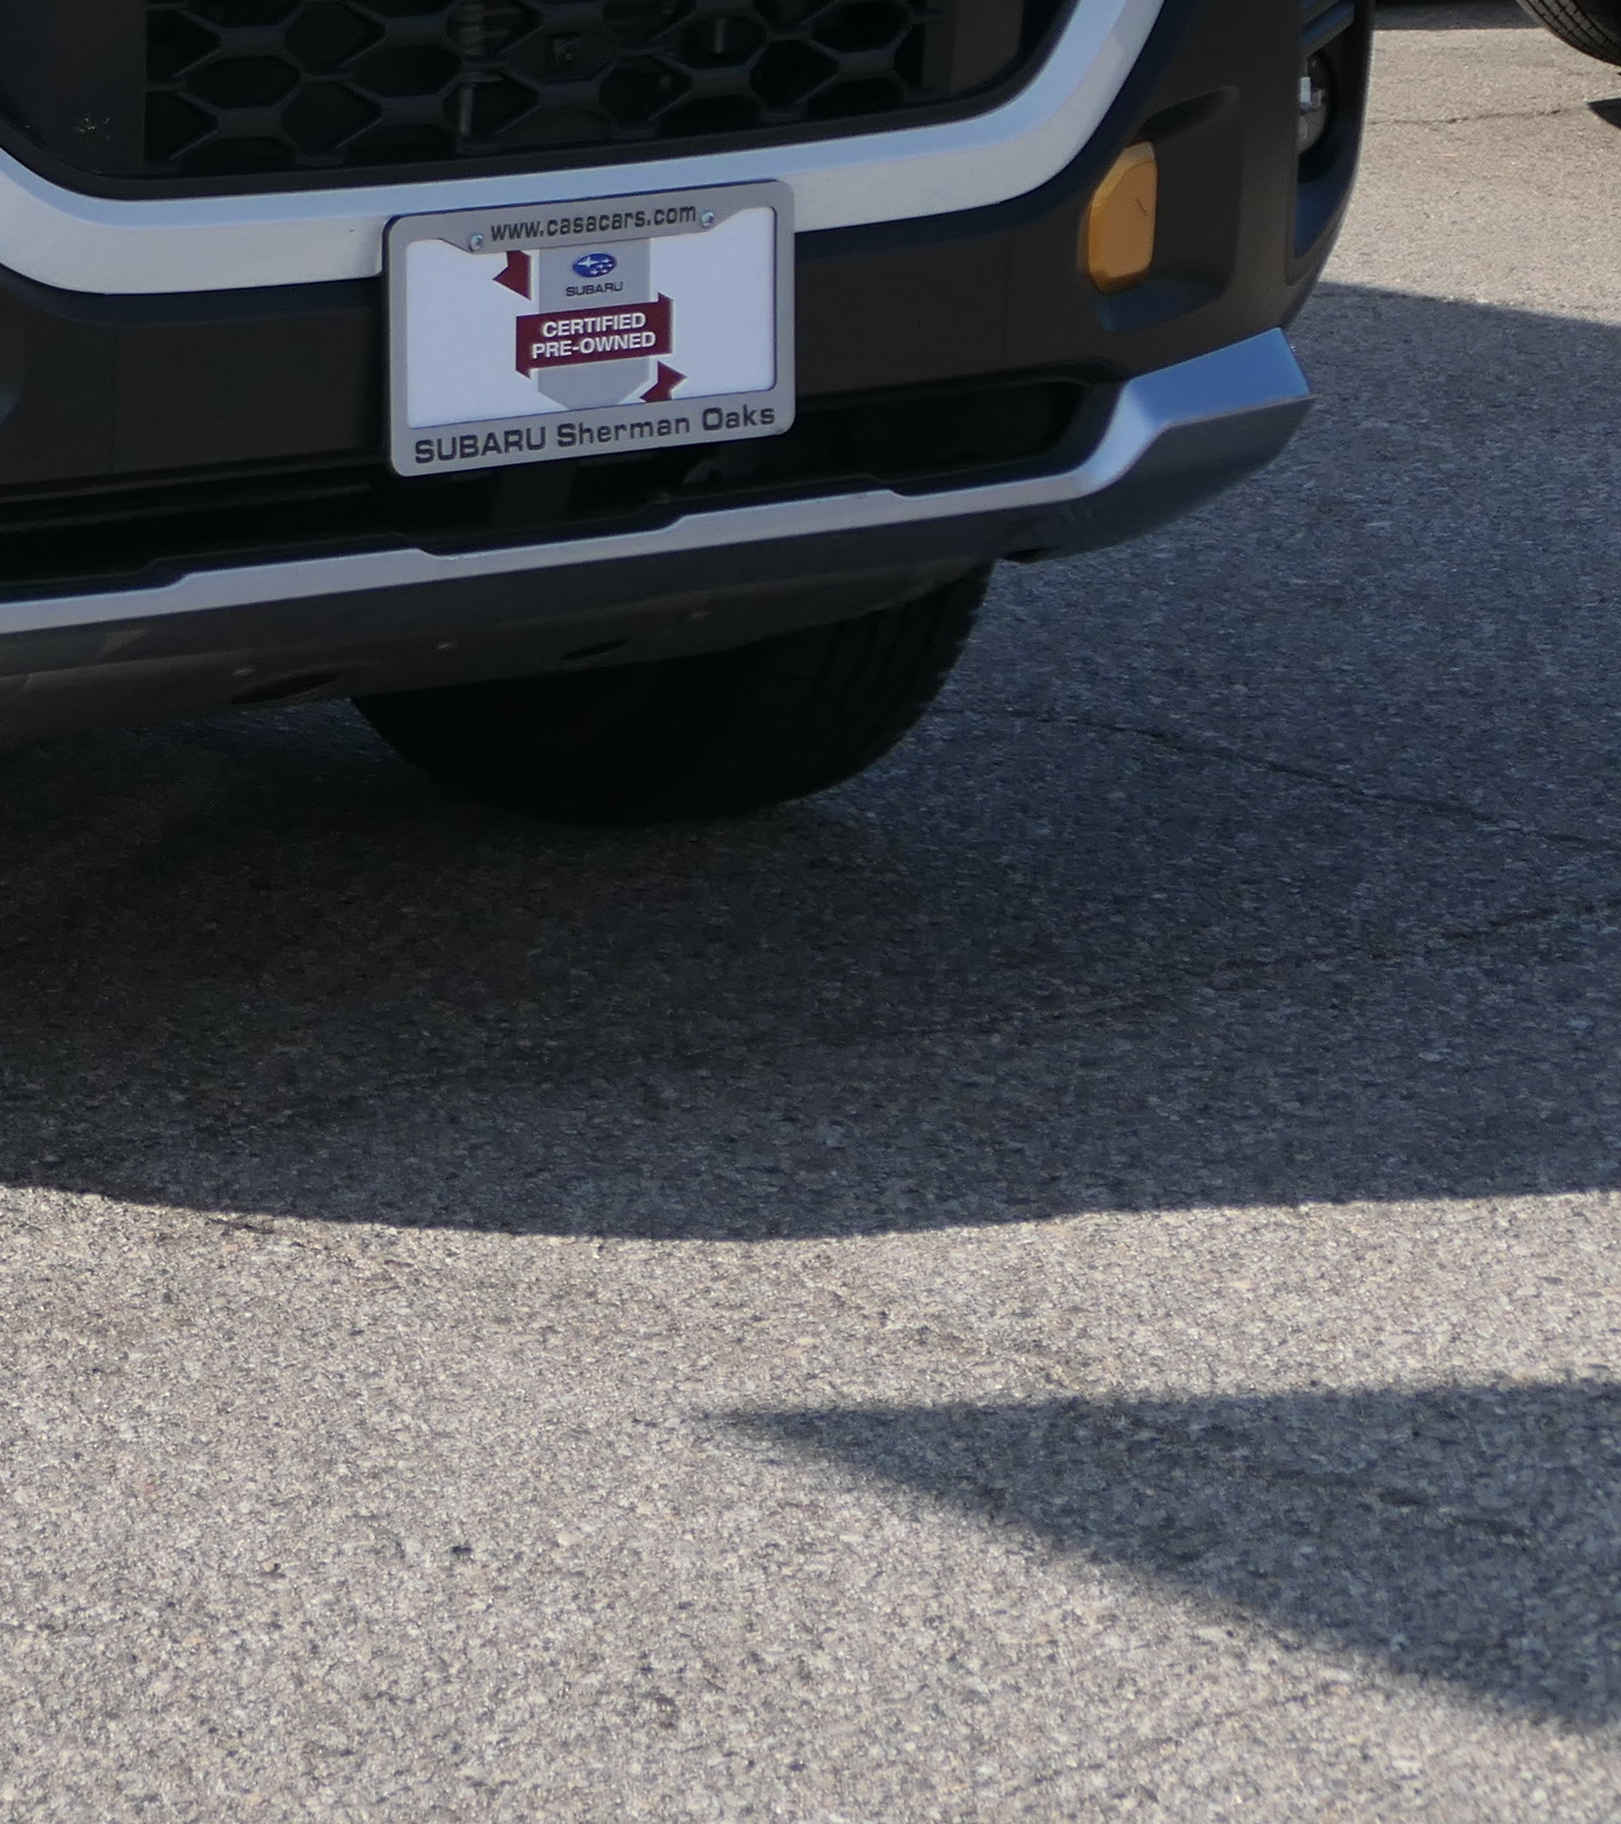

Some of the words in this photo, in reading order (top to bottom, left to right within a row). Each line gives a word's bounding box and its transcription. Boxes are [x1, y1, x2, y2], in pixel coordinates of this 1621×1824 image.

[490, 205, 697, 242] www.casacars.com
[565, 281, 624, 297] SUBARU
[542, 312, 647, 339] CERTIFIED
[532, 331, 657, 360] PRE-OWNED
[414, 426, 546, 465] SUBARU
[556, 415, 691, 449] Sherman
[701, 404, 776, 431] Oaks
